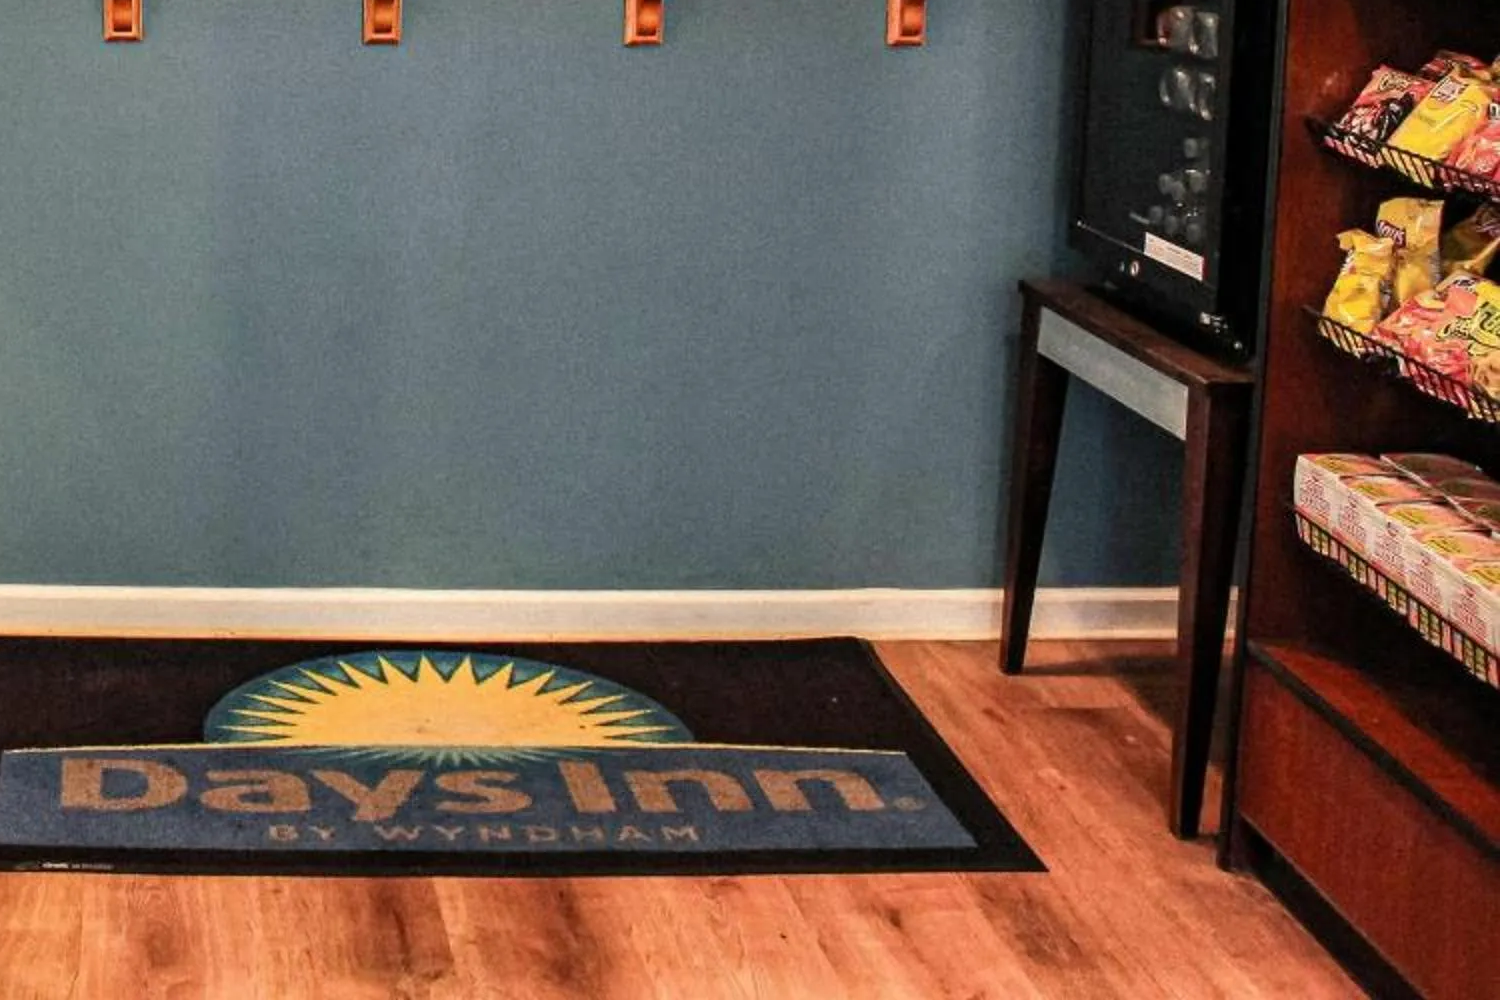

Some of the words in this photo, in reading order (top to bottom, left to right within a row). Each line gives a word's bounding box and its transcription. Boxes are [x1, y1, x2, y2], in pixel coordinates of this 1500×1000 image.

[60, 757, 534, 822] Days
[557, 759, 887, 814] Inn
[268, 824, 336, 842] BY
[372, 824, 700, 842] WYNDHAM
